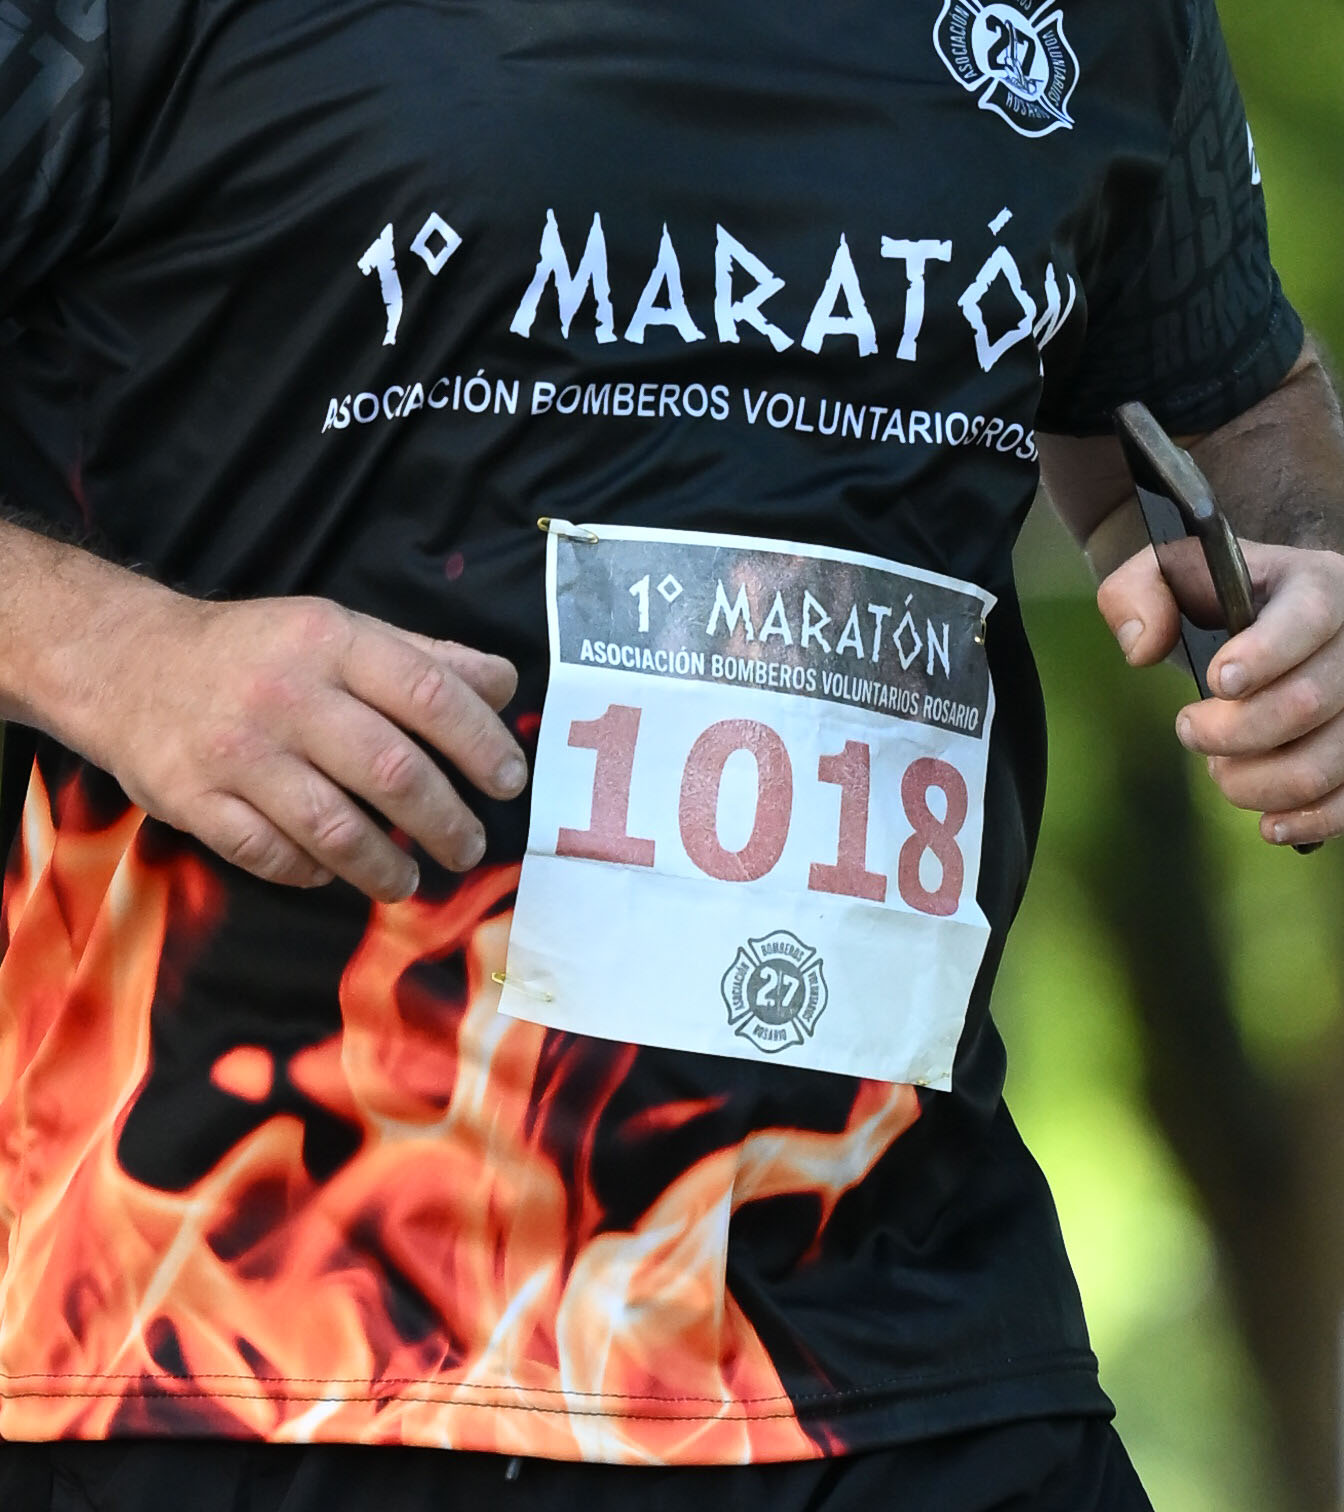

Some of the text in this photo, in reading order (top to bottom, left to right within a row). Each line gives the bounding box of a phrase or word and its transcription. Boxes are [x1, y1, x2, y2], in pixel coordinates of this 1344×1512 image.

[949, 4, 978, 80] ASOCIACIÓN
[985, 14, 1037, 77] 27
[509, 207, 1077, 378] MARATÓN
[321, 369, 1039, 462] ASOCIACIÓN BOMBEROS VOLUNTARIOS ROS
[705, 579, 951, 679] MARATÓN
[580, 638, 979, 732] ASOCIACIÓN BOMBEROS VOLUNTARIOS ROSARIO
[556, 703, 969, 917] 1018
[756, 966, 800, 1007] 27
[761, 942, 805, 962] BOMBEROS
[752, 1024, 788, 1041] ROSARIO
